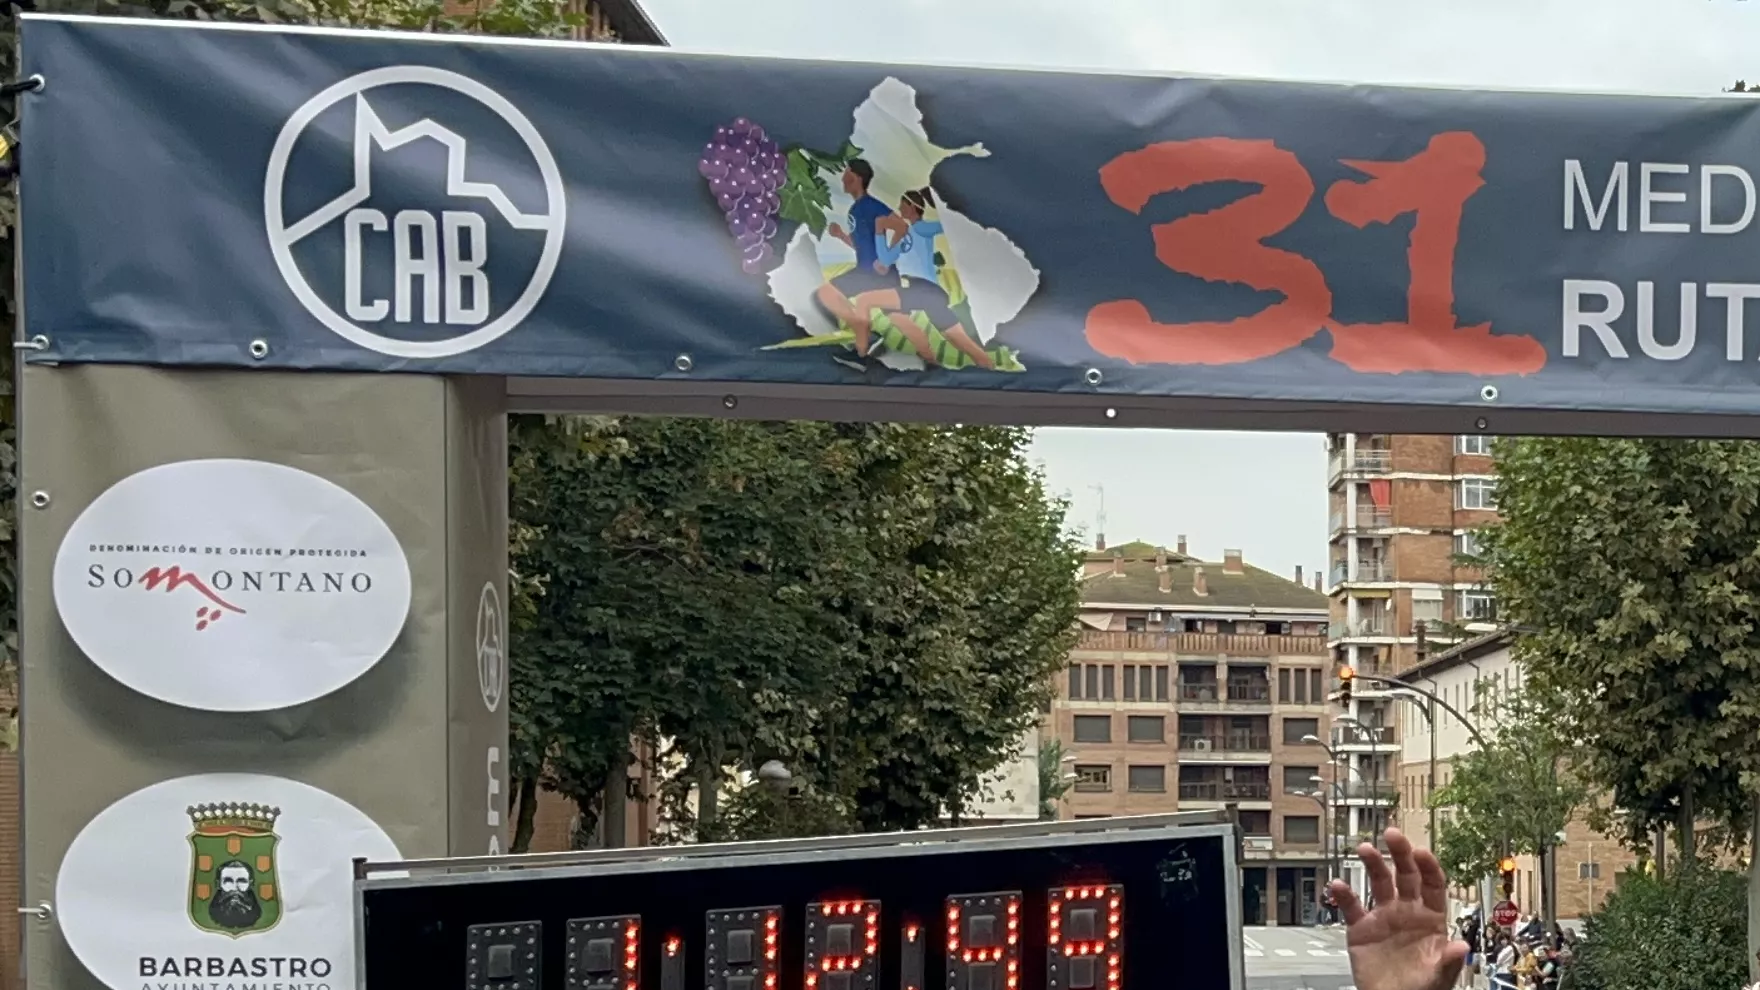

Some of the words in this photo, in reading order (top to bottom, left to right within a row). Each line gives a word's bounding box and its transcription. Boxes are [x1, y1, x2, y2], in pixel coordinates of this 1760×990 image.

[344, 208, 490, 325] CAB
[1085, 131, 1546, 376] 31
[88, 543, 197, 555] DENOMINACIÓN
[204, 546, 222, 556] DE
[229, 547, 282, 557] ORIGEN
[88, 563, 372, 602] SOMONTANO
[138, 956, 333, 978] BARBASTRO
